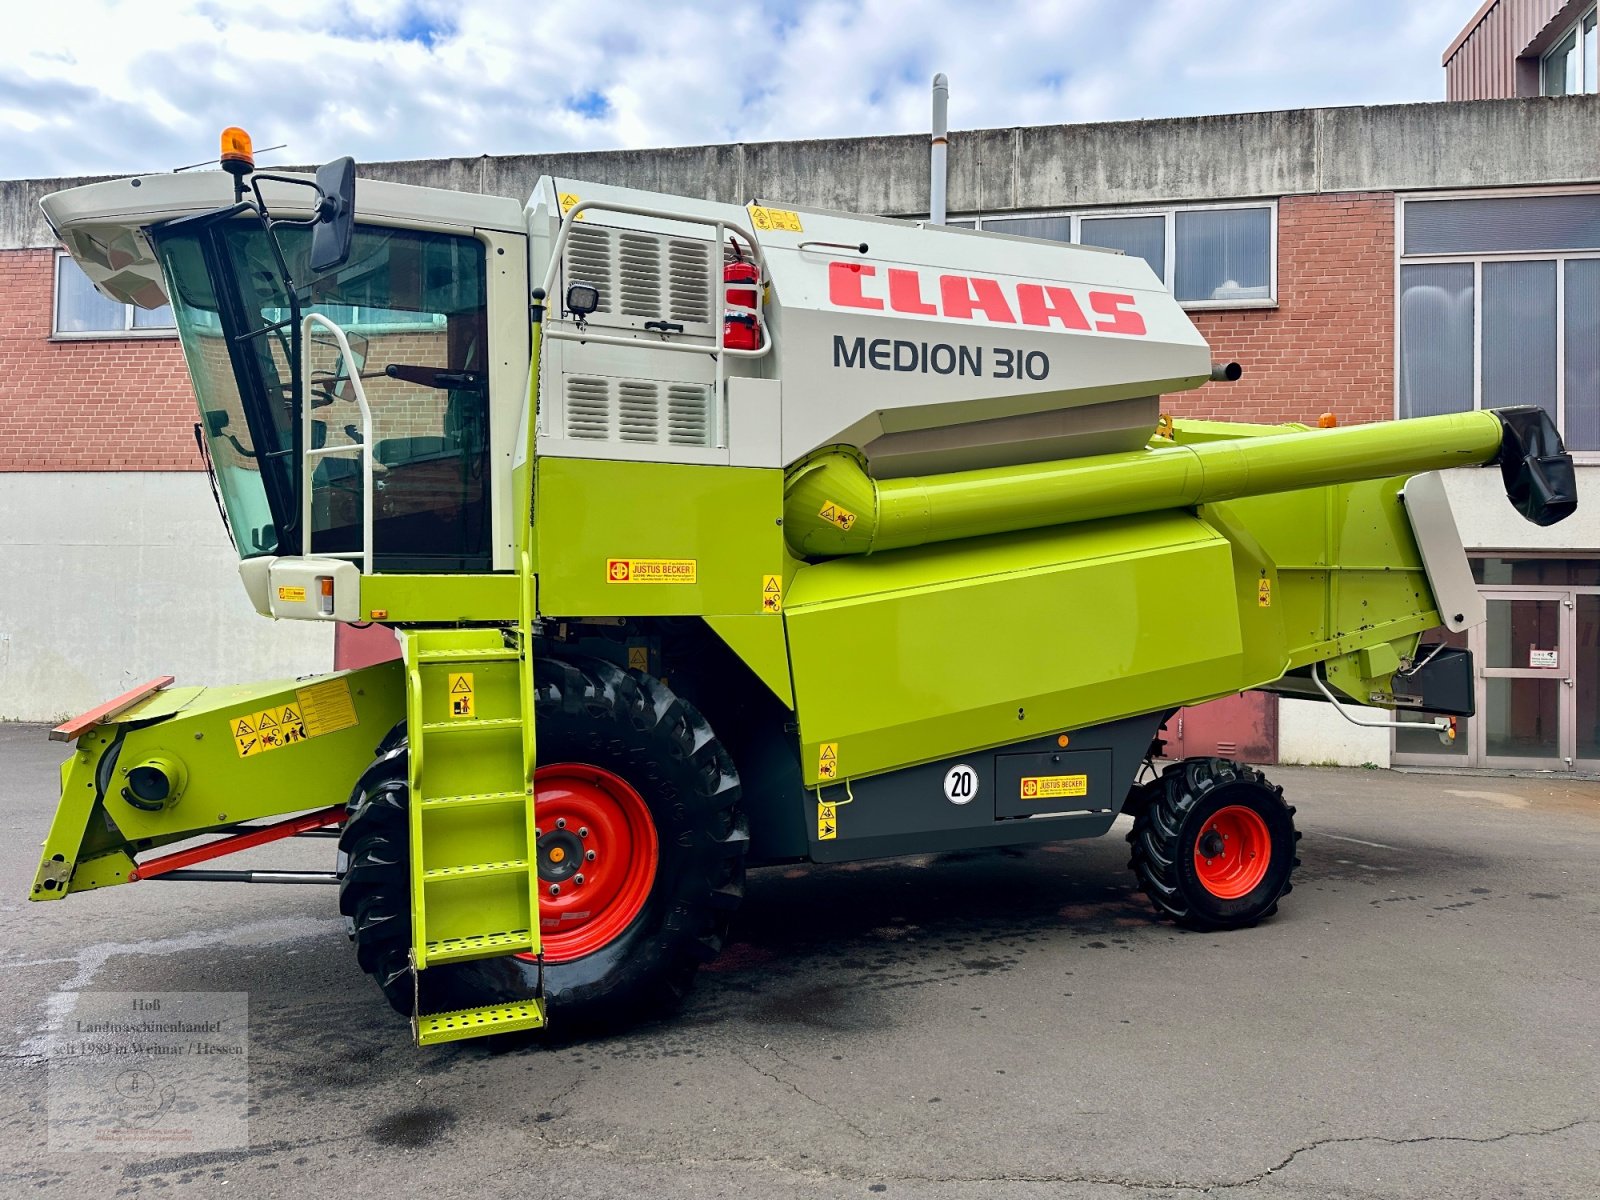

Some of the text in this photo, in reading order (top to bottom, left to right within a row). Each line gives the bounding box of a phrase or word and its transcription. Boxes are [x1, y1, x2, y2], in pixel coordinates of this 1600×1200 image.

[828, 261, 1147, 336] CLAAS
[833, 335, 1049, 381] MEDION 310
[633, 565, 660, 574] JUSTUS
[662, 565, 690, 574] BECKER
[951, 771, 971, 797] 20
[1039, 780, 1061, 789] JUSTUS
[1061, 779, 1083, 788] BECKER
